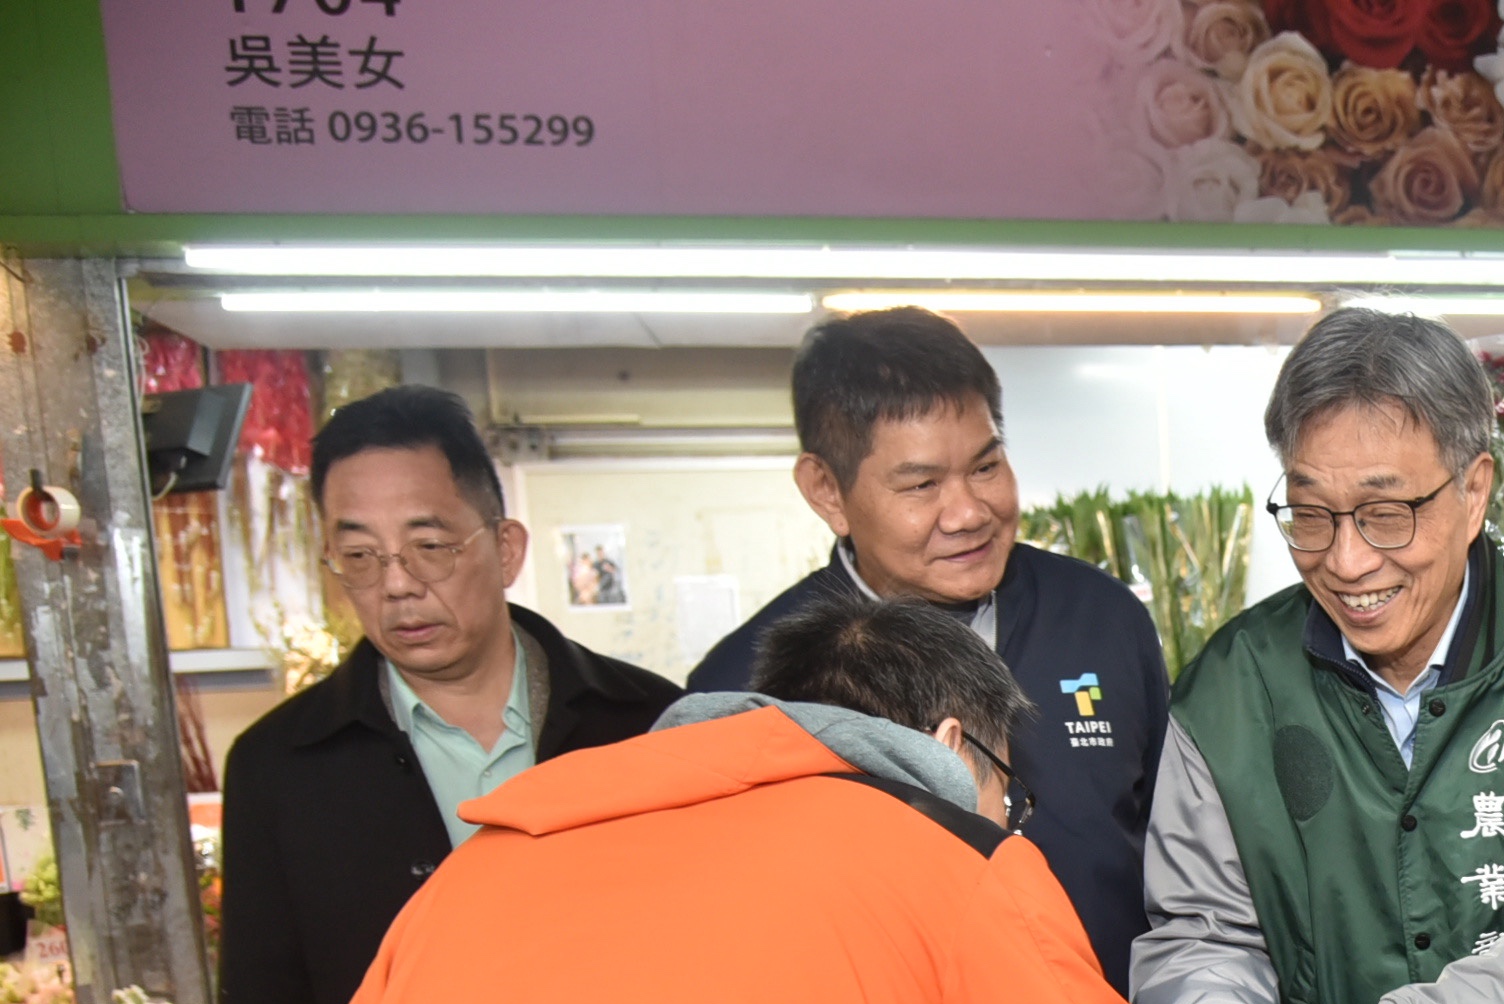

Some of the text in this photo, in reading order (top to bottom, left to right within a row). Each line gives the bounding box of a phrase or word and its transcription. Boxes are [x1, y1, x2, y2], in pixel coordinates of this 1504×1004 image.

[225, 35, 404, 89] 吳美女
[230, 107, 595, 147] 電話 0936-155299
[1064, 721, 1112, 734] TAIPEI
